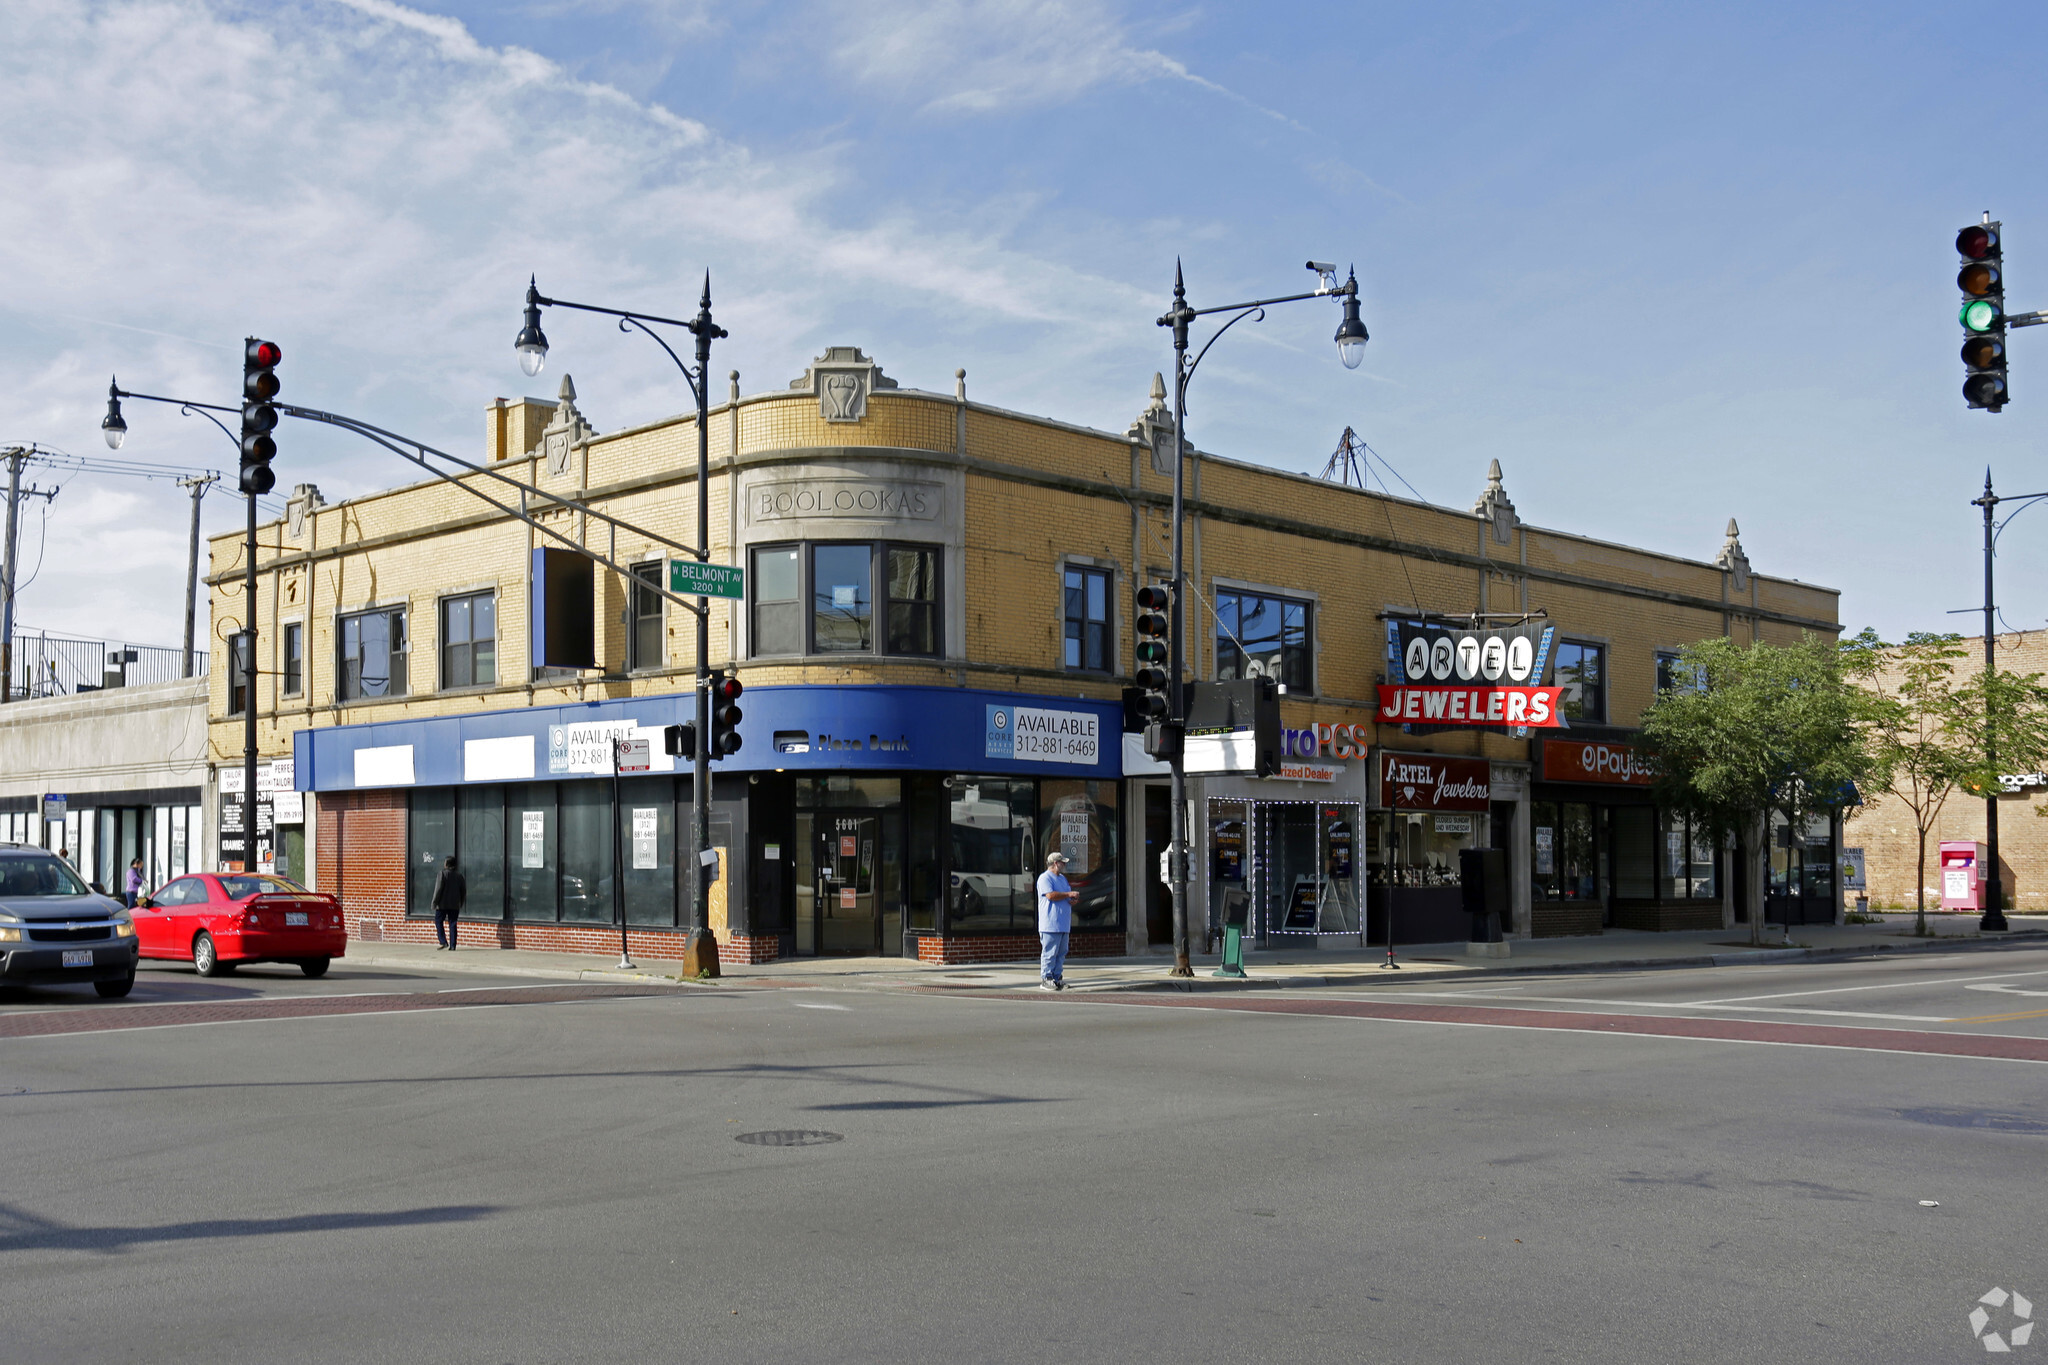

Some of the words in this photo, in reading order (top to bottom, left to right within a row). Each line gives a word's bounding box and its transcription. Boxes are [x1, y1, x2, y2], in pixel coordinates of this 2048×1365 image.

[761, 490, 926, 515] BOOLOOKAS
[672, 566, 679, 575] W
[681, 565, 731, 583] BELMONT
[732, 573, 742, 582] AV
[691, 581, 713, 593] 3200
[717, 584, 724, 593] N
[1408, 643, 1528, 672] ARTEL
[1382, 690, 1550, 723] JEWELERS
[1017, 715, 1095, 737] AVAILABLE
[988, 732, 1012, 741] CORE
[1280, 720, 1368, 760] troPCS
[869, 734, 909, 751] Bank
[1016, 735, 1096, 757] 312-881-6469
[550, 749, 568, 758] CORE
[570, 749, 615, 765] 312-881-
[224, 770, 241, 779] TAILOR
[274, 764, 294, 774] PERFEC
[1304, 767, 1333, 780] Dealer
[226, 781, 239, 789] SHOP
[1386, 758, 1434, 784] ARTEL
[1433, 766, 1489, 805] Jewelers
[523, 813, 543, 822] AVAILABLE
[633, 810, 656, 820] AVAILABLE
[1061, 815, 1087, 824] AVAILABLE
[1435, 816, 1452, 824] CLOSED
[1453, 816, 1470, 824] SUNDAY
[641, 820, 651, 828] (312)
[835, 819, 857, 830] 5601
[1067, 825, 1080, 833] (312)
